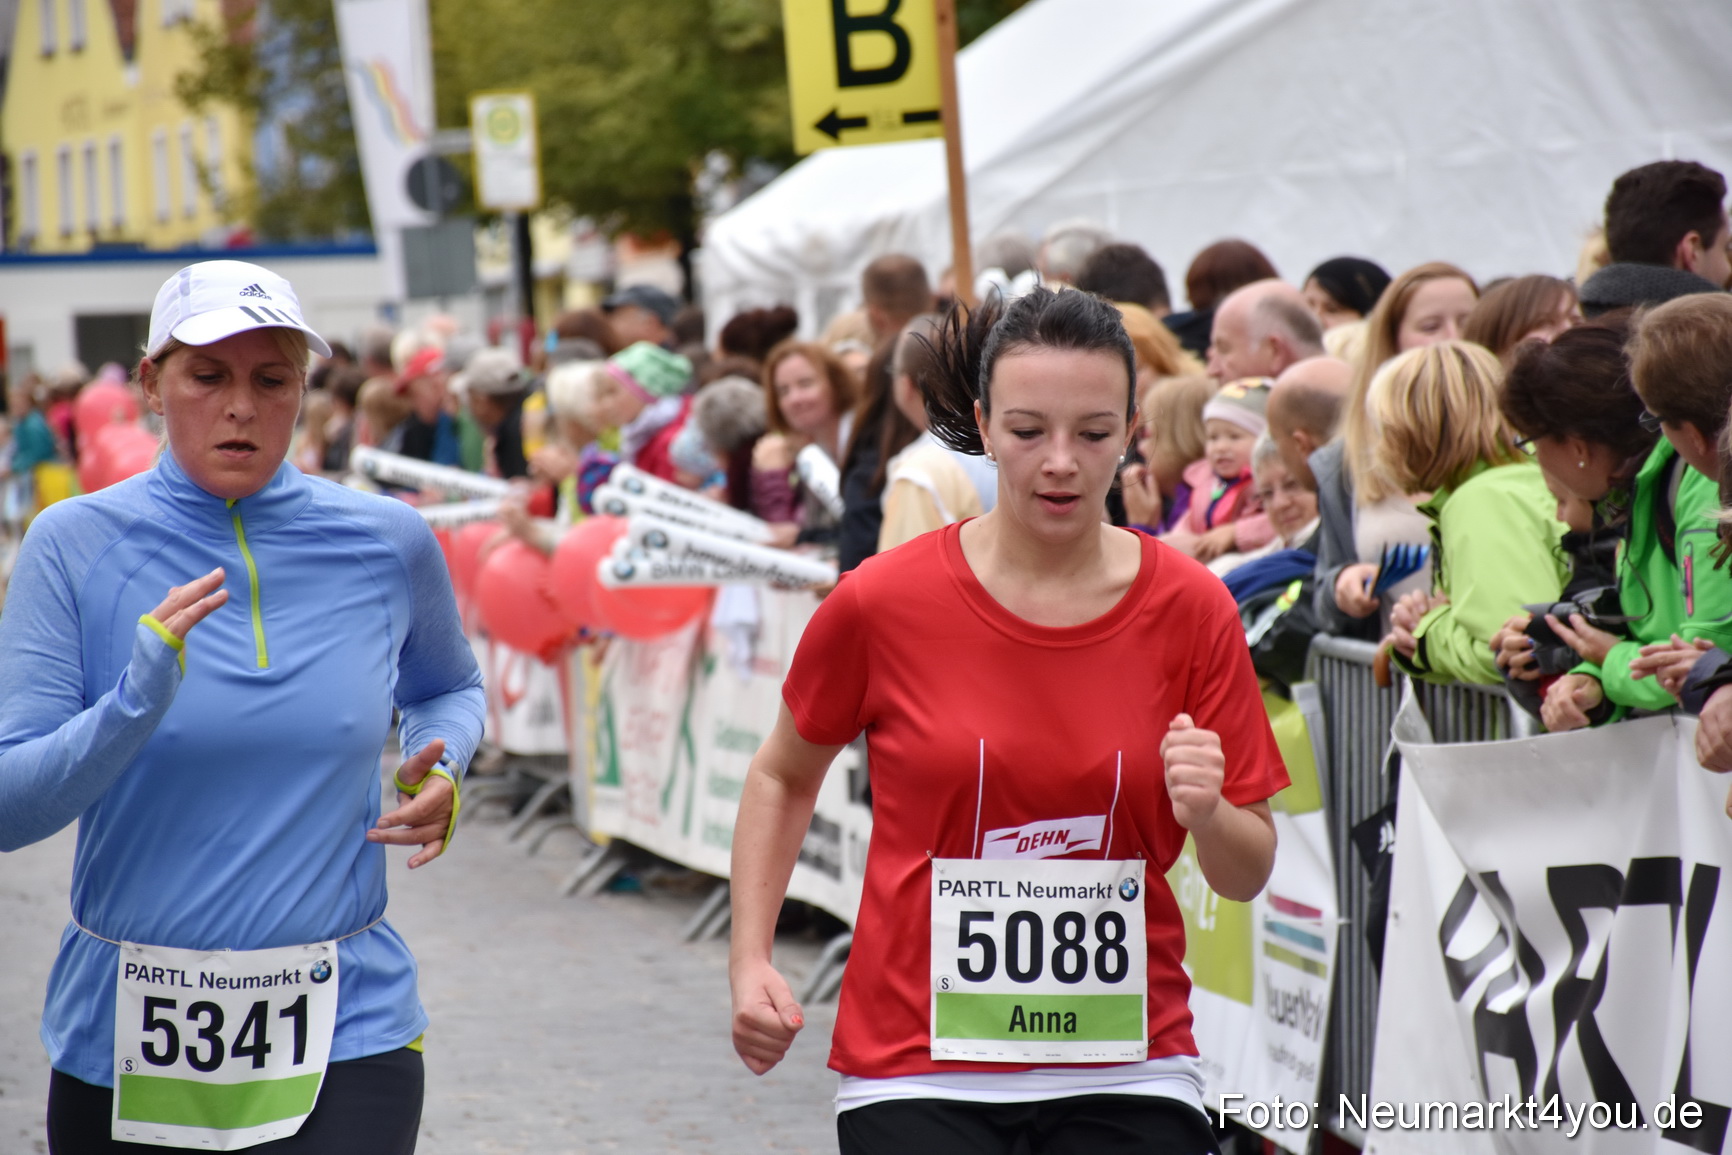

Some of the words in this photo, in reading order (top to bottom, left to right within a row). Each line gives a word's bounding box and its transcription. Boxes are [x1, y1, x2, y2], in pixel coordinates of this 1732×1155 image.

[832, 0, 912, 88] B
[239, 290, 272, 301] adidas
[1016, 829, 1070, 854] DEHN
[938, 879, 1010, 899] PARTL
[1017, 881, 1113, 900] Neumarkt
[957, 910, 1129, 984] 5088
[124, 962, 193, 988] PARTL
[199, 968, 301, 990] Neumarkt
[940, 977, 950, 990] S
[1008, 1004, 1077, 1034] Anna
[141, 994, 308, 1073] 5341
[124, 1060, 134, 1072] S
